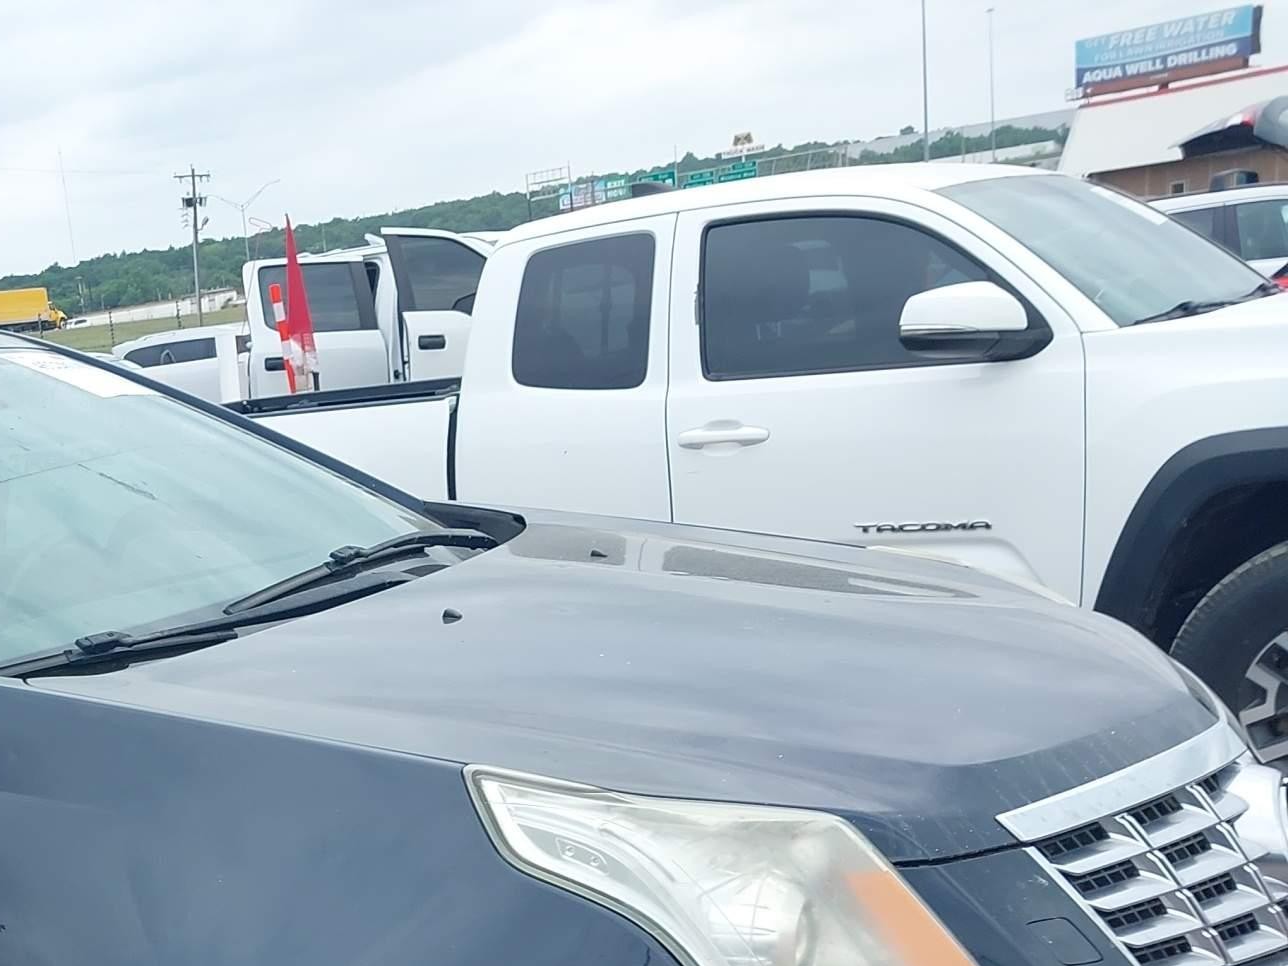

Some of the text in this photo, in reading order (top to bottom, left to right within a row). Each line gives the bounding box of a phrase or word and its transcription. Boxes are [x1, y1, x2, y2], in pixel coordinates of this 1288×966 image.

[1108, 26, 1158, 49] FREE
[1163, 11, 1236, 38] WATER
[1082, 43, 1239, 84] AQUA WELL DRILLING
[853, 520, 993, 534] TACOMA
